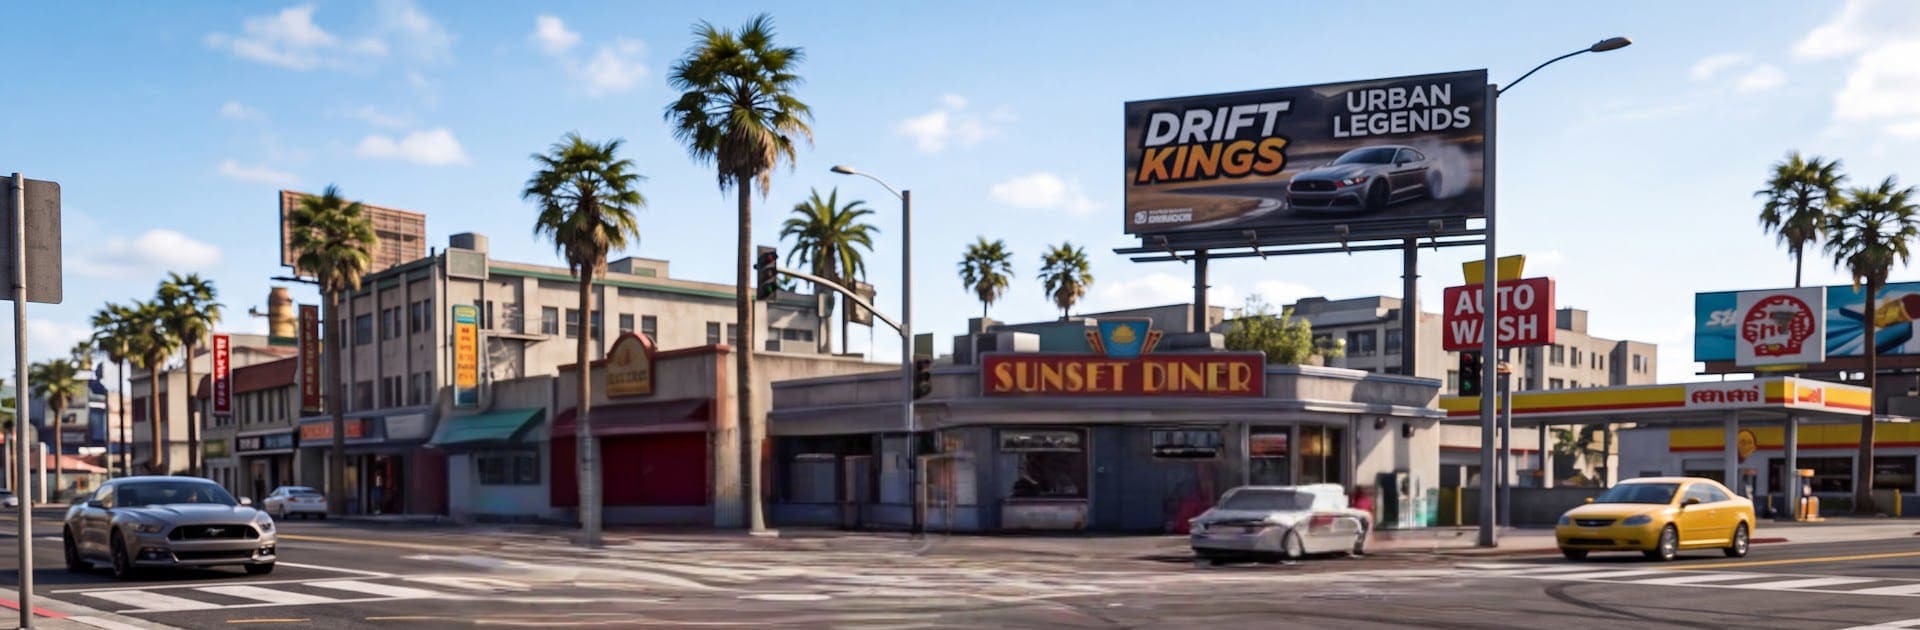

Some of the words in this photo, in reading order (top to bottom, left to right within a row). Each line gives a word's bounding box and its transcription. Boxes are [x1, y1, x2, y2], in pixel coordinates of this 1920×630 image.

[1346, 83, 1451, 113] URBAN
[1144, 101, 1290, 147] DRIFT
[1333, 106, 1471, 138] LEGENDS
[1138, 136, 1288, 182] KINGS
[1450, 314, 1538, 345] WSH
[994, 361, 1130, 393] SUNSET
[1143, 361, 1252, 392] DINER
